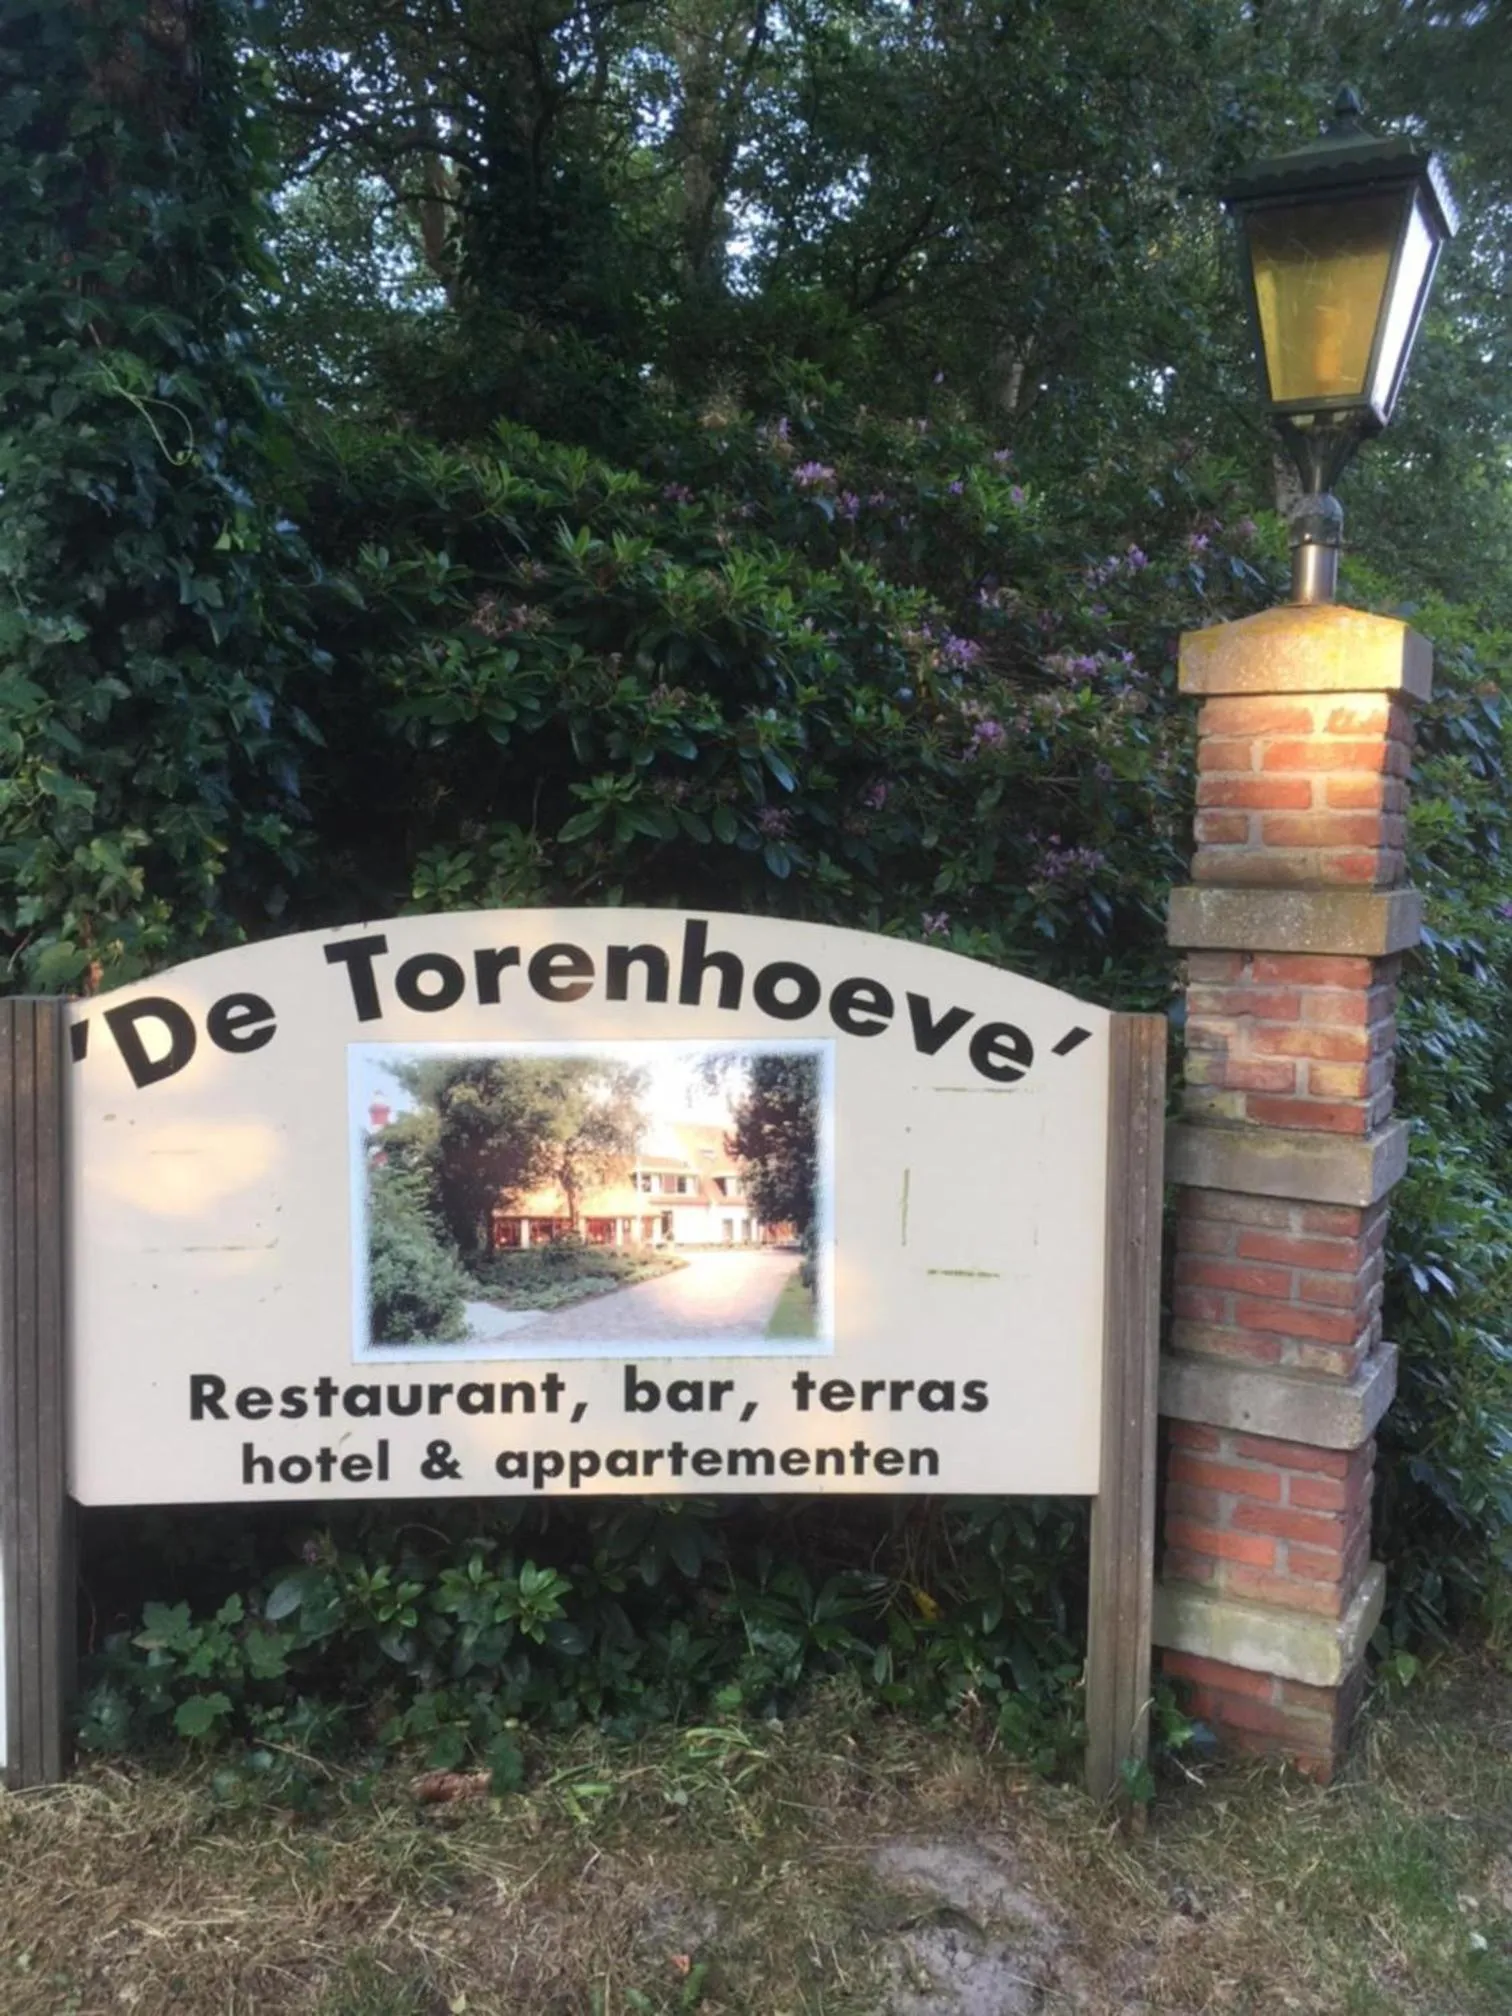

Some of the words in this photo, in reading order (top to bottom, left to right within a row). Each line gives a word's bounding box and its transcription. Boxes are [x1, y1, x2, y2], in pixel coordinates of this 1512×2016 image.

[190, 1373, 587, 1421] Restaurant,
[624, 1364, 758, 1423] bar,
[792, 1371, 988, 1413] terras
[243, 1439, 389, 1484] hotel
[420, 1439, 462, 1480] &
[495, 1441, 939, 1490] appartementen
